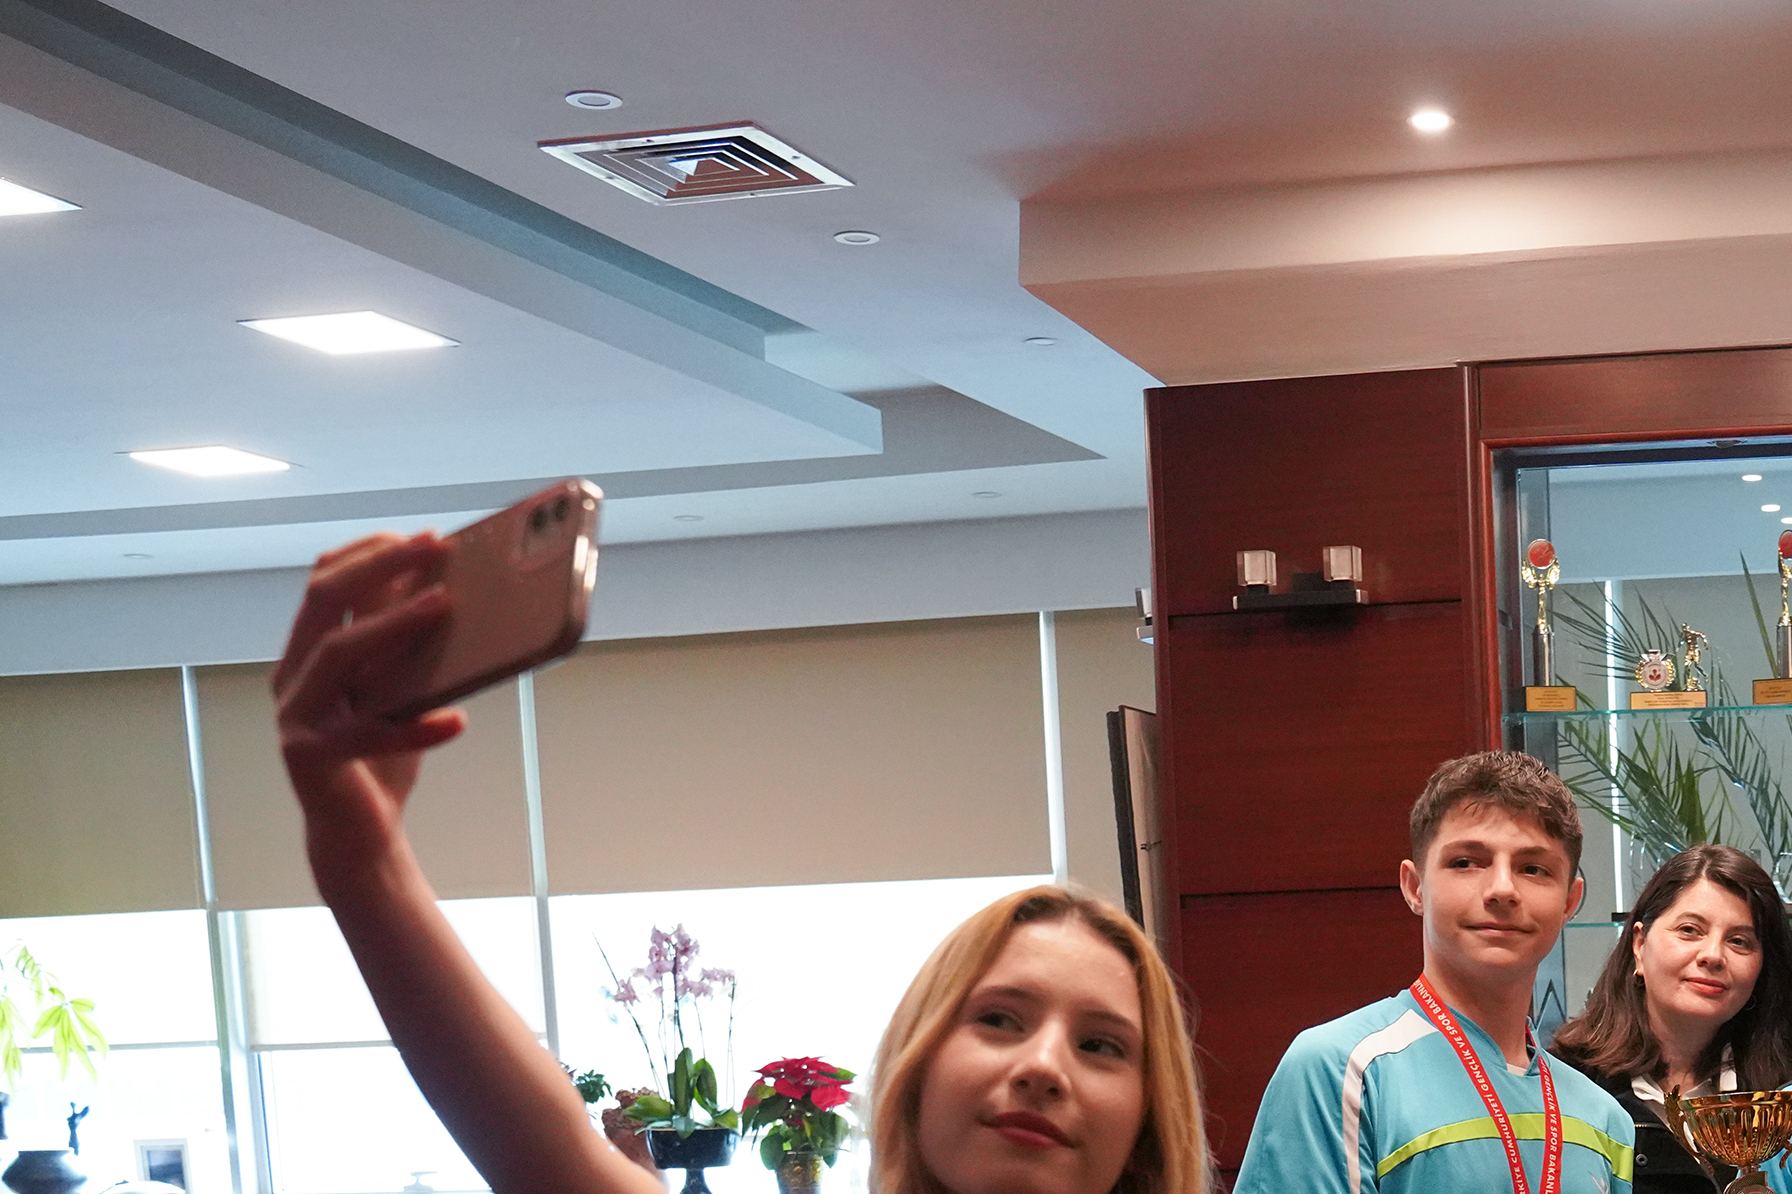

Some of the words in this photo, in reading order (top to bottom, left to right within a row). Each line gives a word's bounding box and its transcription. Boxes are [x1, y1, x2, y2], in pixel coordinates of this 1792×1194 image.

[1437, 1013, 1458, 1035] SPOR
[1454, 1036, 1466, 1048] VE
[1462, 1049, 1490, 1091] GENÇLİK
[1483, 1094, 1518, 1164] CUMHURİYETİ
[1549, 1114, 1557, 1125] VE
[1550, 1126, 1558, 1152] SPOR
